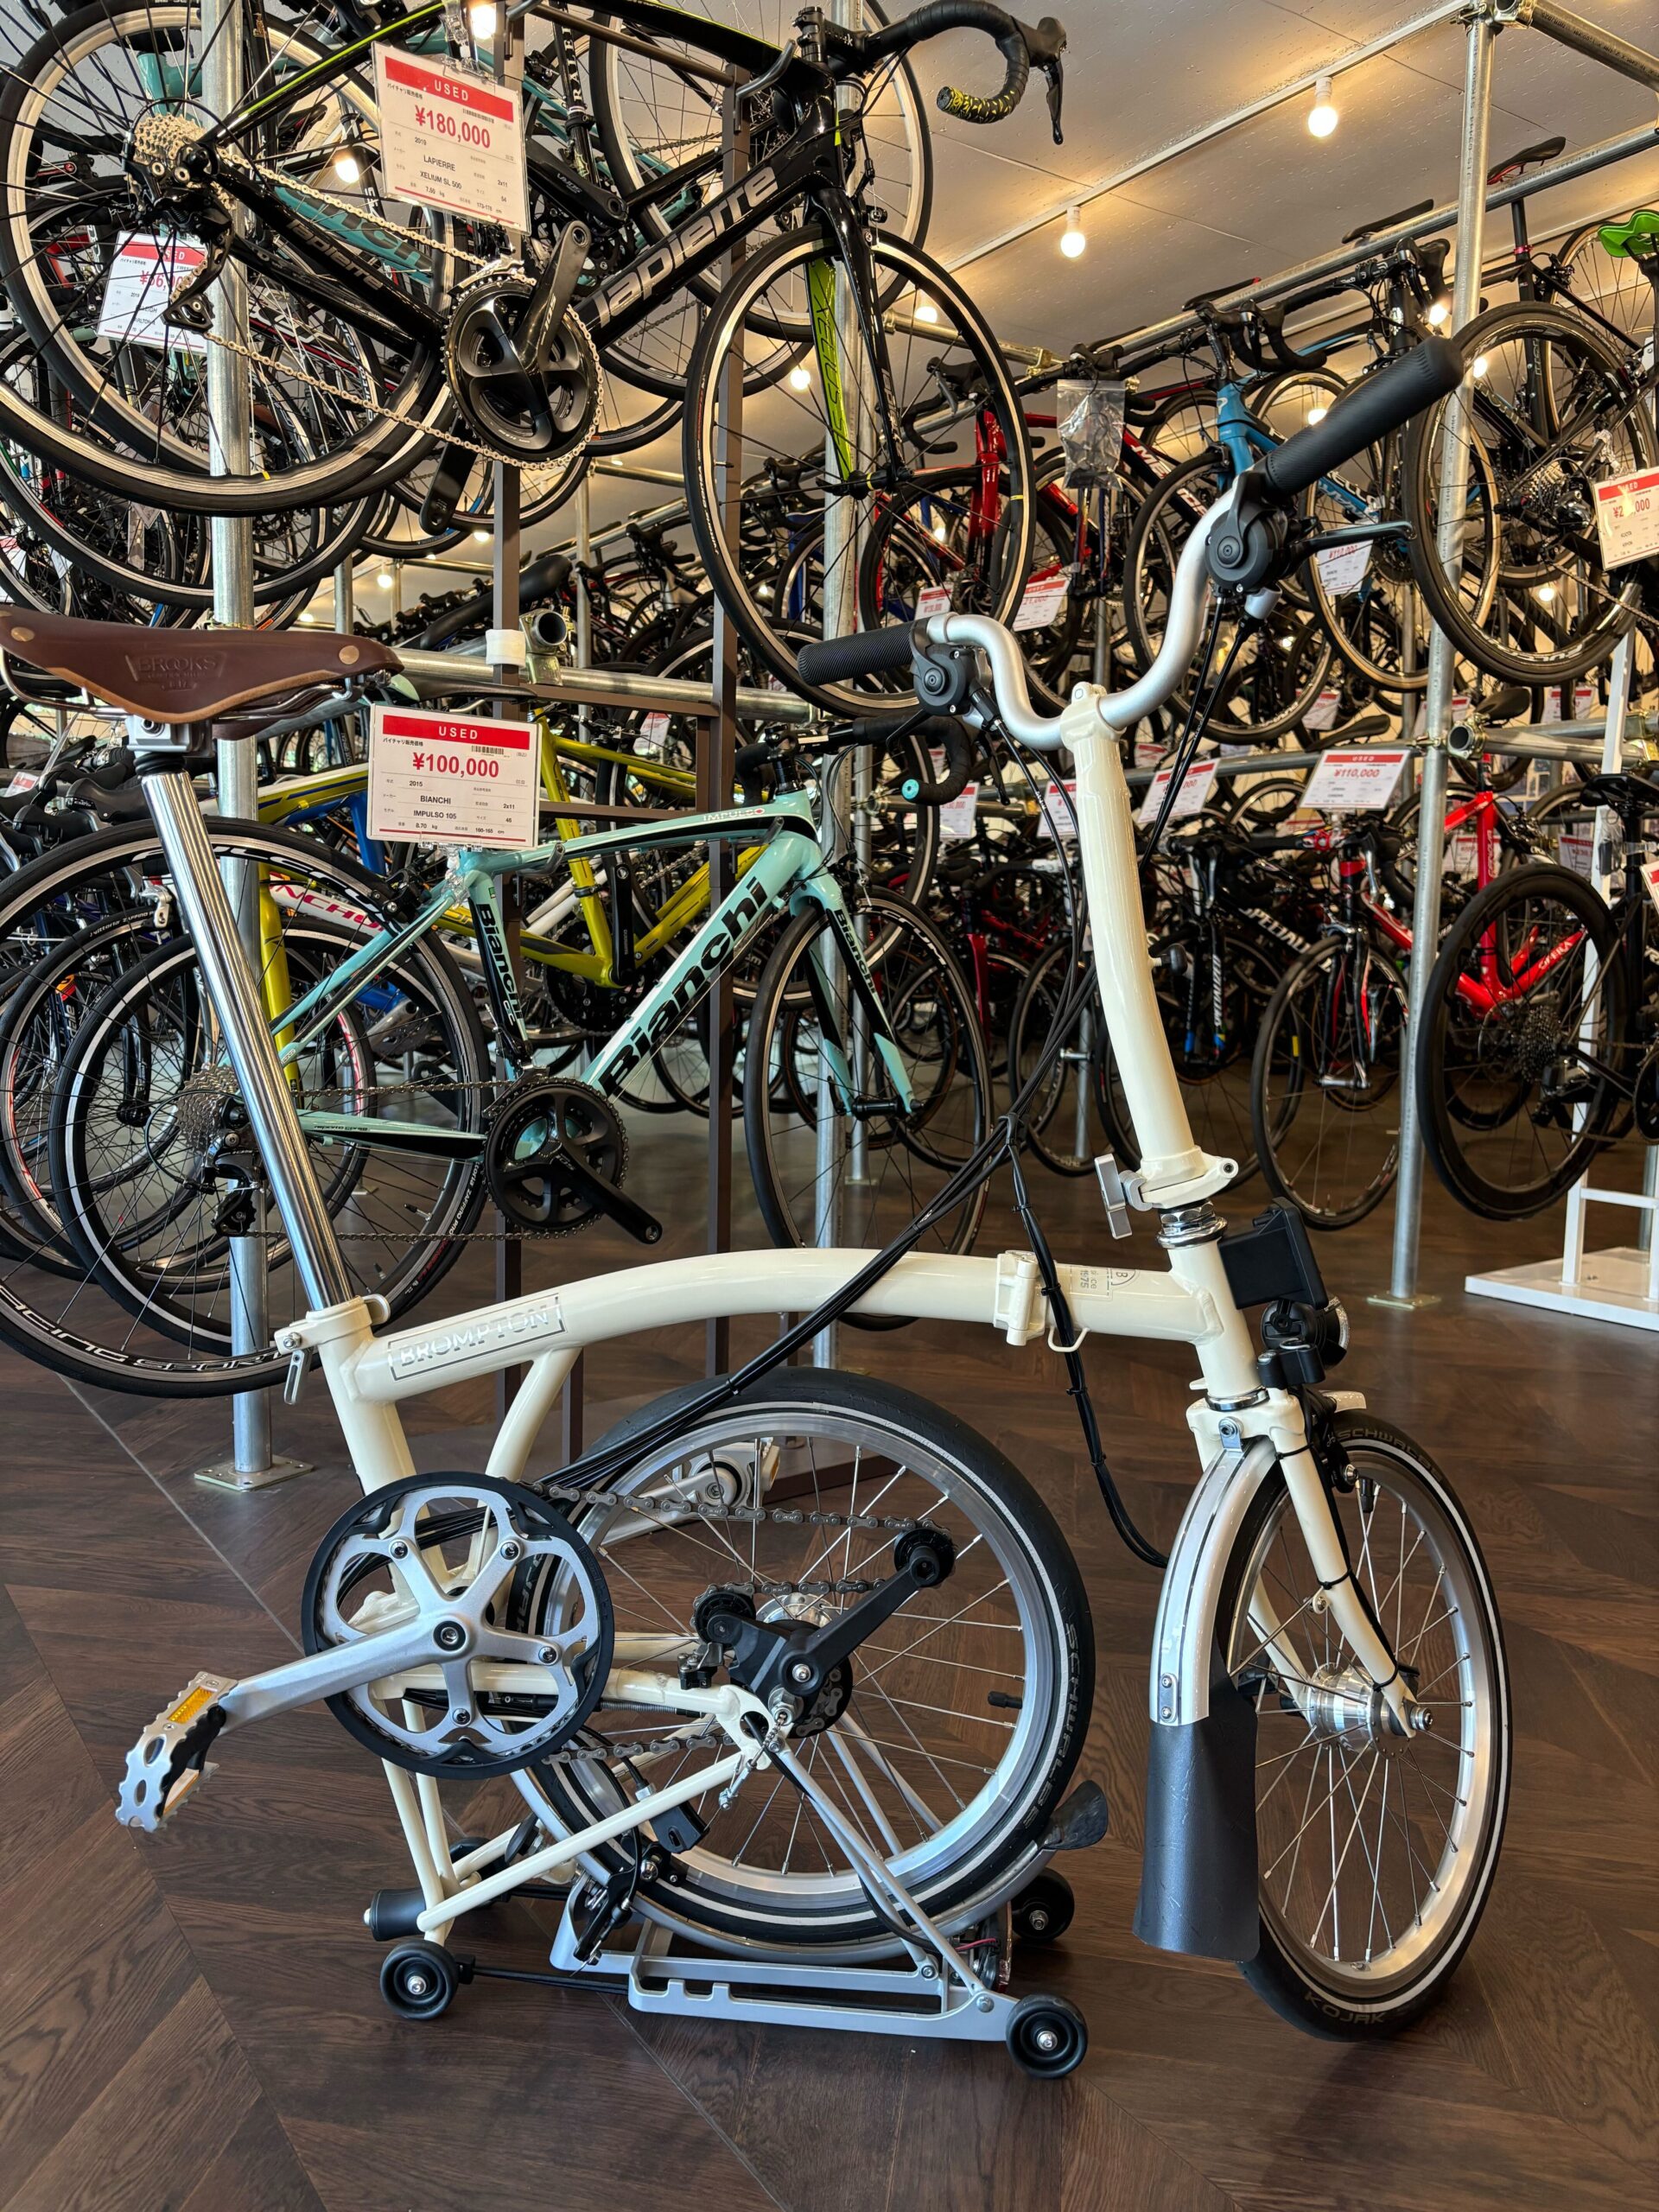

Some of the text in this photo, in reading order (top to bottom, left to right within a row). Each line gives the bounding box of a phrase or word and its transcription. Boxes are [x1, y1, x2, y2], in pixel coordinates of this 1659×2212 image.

[562, 26, 583, 102] RALEI
[434, 79, 469, 101] USED
[415, 105, 490, 149] ¥180,000
[415, 137, 427, 146] 2019
[420, 170, 461, 190] XELIUM SL 500
[423, 155, 456, 172] LAPIERRE
[286, 219, 384, 290] lapierre
[594, 166, 779, 329] lapierre
[543, 293, 556, 331] 105
[813, 294, 840, 405] XELIUS
[138, 658, 216, 671] BROOKS
[438, 726, 478, 740] USED
[412, 752, 499, 778] ¥100,000
[1333, 768, 1381, 779] ¥110,000
[413, 810, 444, 819] IMPULSO
[420, 795, 451, 805] BIANCHI
[702, 807, 765, 822] IMPULSO
[476, 903, 524, 1020] Bianchi
[833, 909, 876, 994] Bianchi
[596, 875, 768, 1097] Bianchi
[401, 1306, 549, 1367] BROMPTON
[1338, 1427, 1444, 1482] SCHWALBE
[1023, 1622, 1080, 1830] SCHWALBE
[1305, 1990, 1386, 2024] KOJAK
